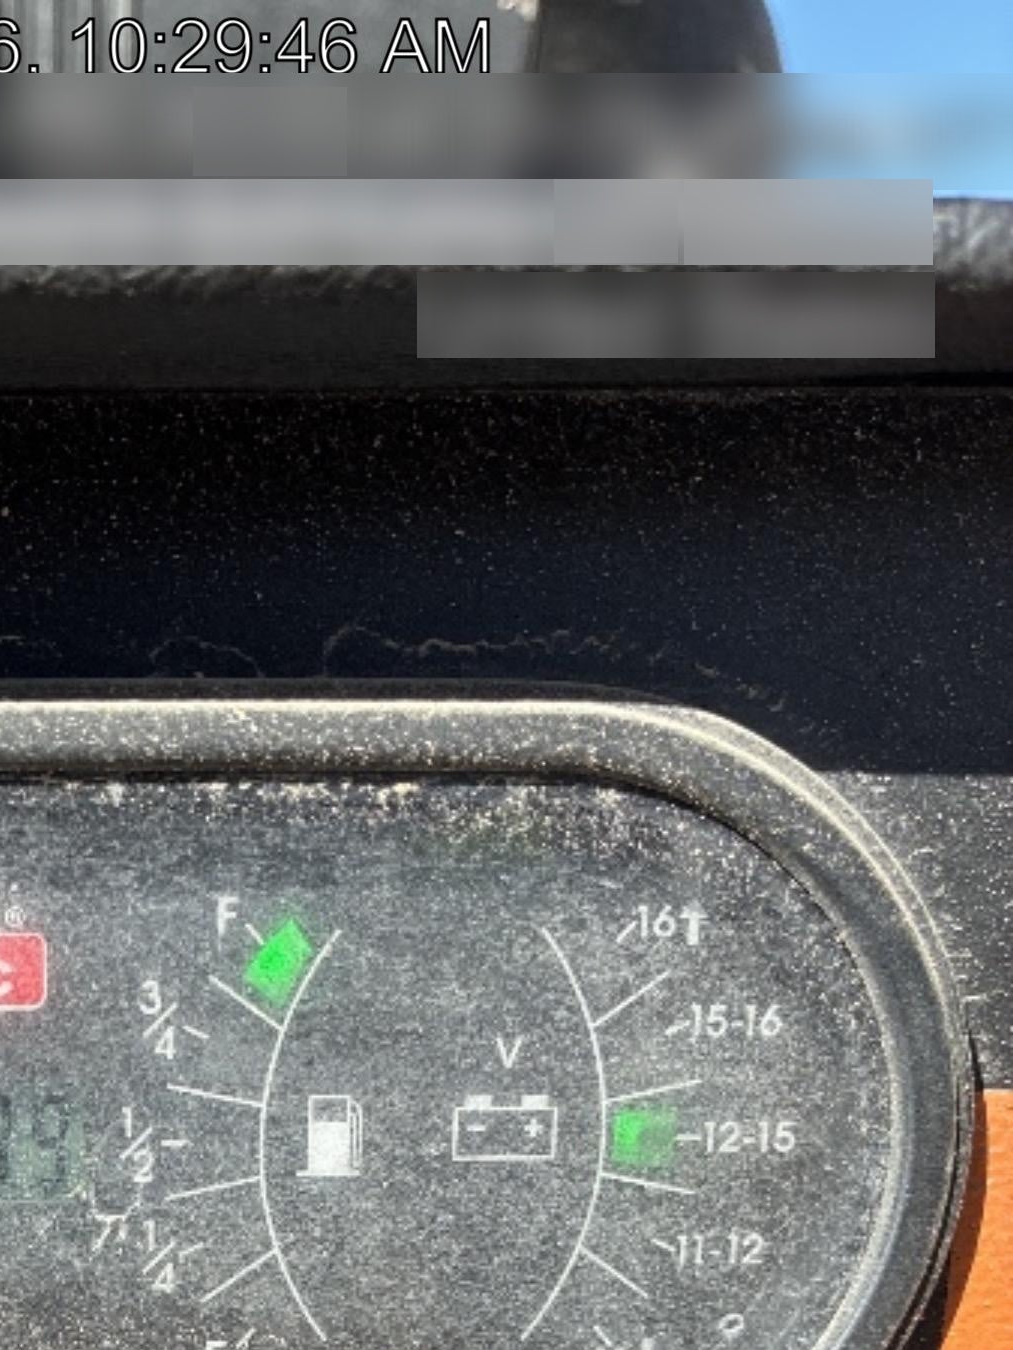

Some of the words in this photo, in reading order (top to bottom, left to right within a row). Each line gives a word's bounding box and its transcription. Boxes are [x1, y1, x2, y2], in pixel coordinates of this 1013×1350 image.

[215, 898, 239, 936] F
[638, 905, 676, 937] 16
[691, 1003, 783, 1037] 15-16
[496, 1038, 524, 1068] V
[704, 1122, 796, 1153] 12-15
[677, 1233, 764, 1266] 11-12
